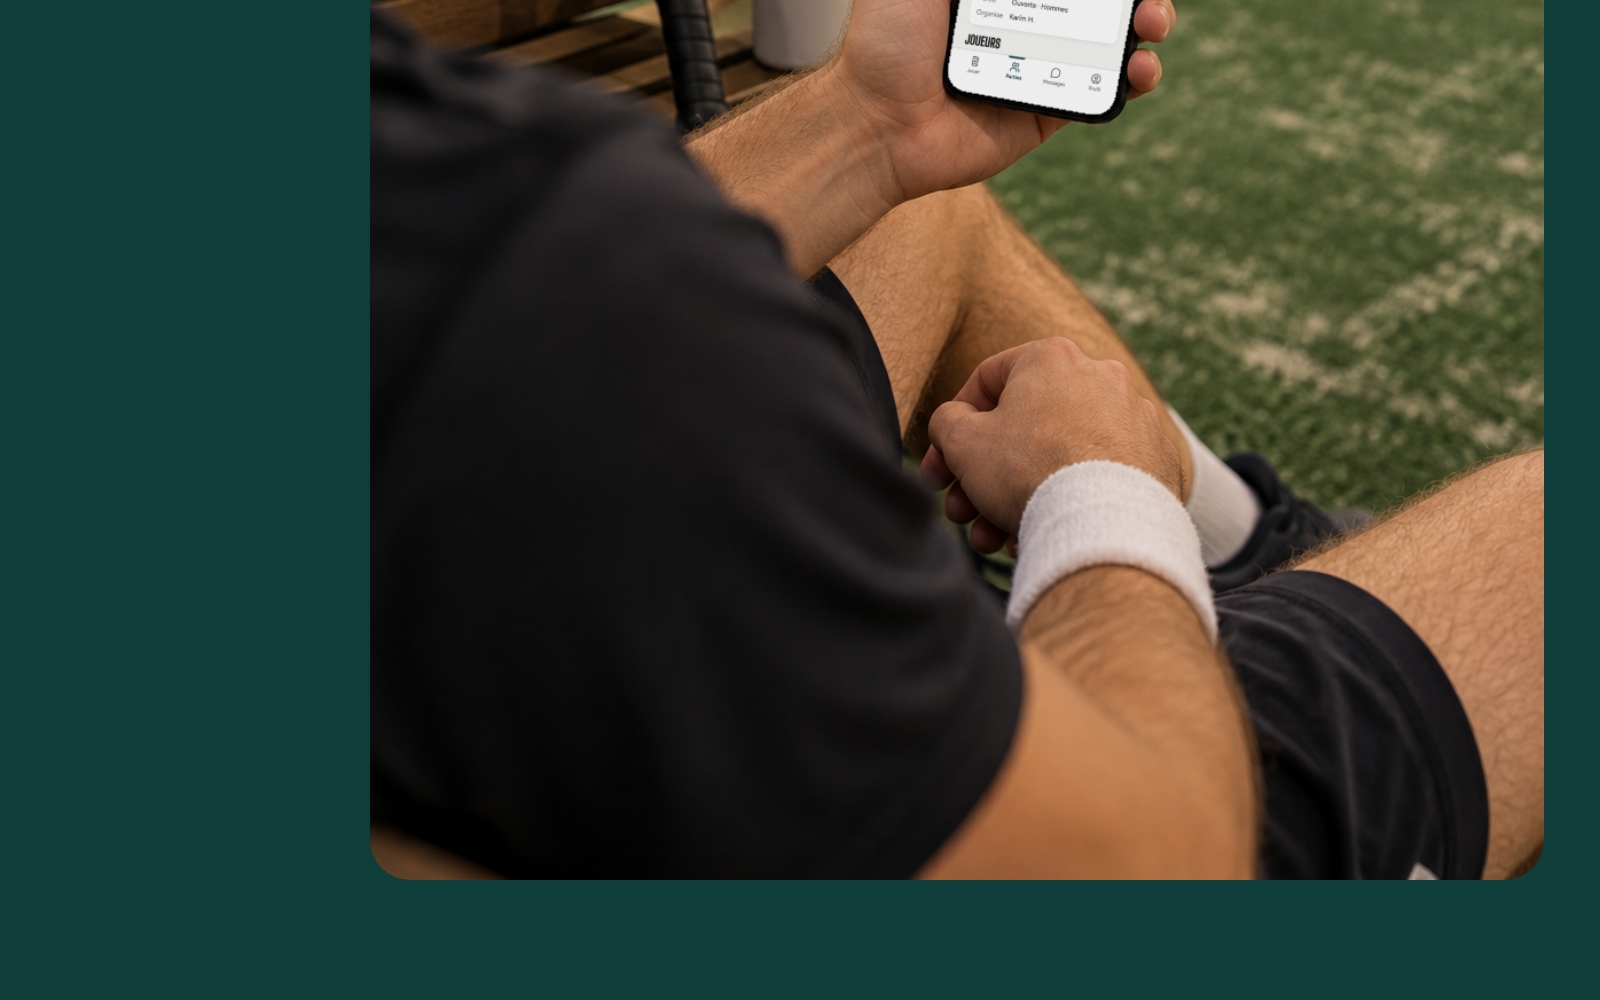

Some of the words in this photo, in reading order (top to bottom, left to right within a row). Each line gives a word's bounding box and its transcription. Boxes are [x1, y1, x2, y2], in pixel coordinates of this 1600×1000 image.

[1040, 3, 1068, 13] Hommes
[1009, 14, 1026, 22] Karim
[964, 33, 1002, 49] JOUEURS
